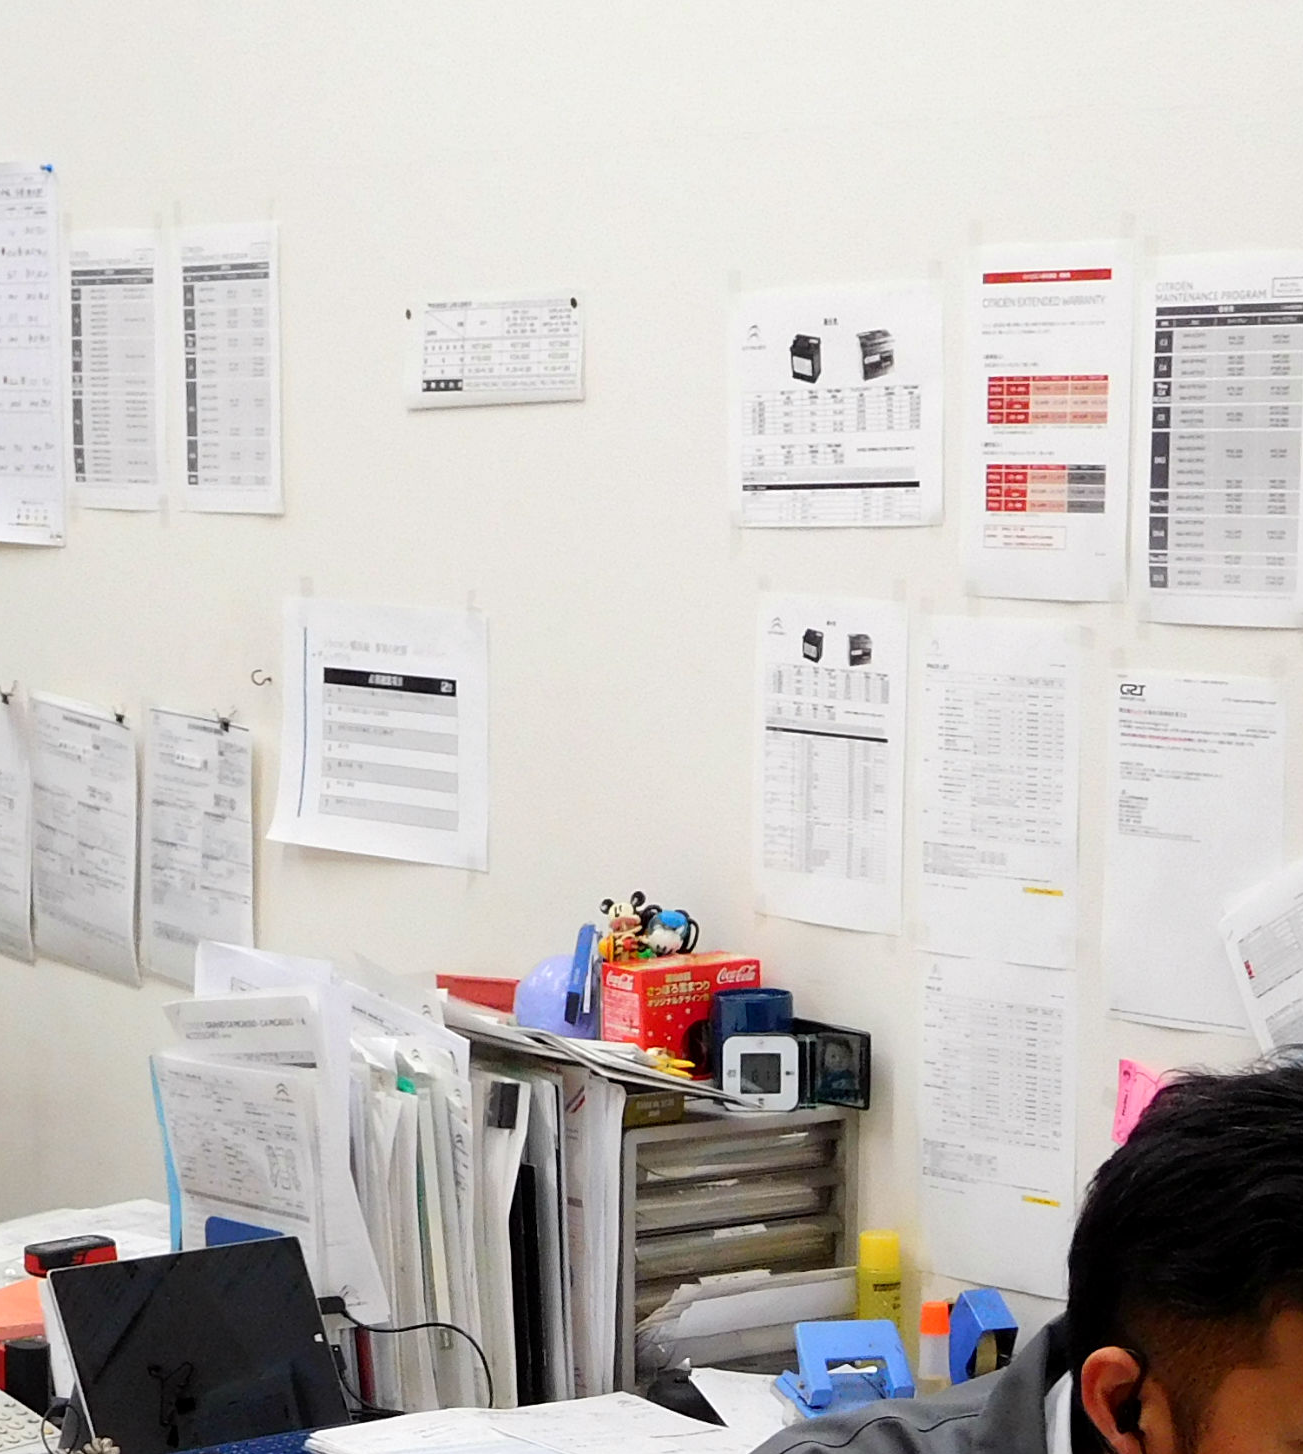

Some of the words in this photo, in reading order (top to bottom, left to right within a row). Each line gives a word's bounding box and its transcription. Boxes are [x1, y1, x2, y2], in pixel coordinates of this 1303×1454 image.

[1017, 295, 1060, 307] EXTENDED
[1062, 294, 1107, 306] WARRANTY
[1155, 291, 1219, 302] MAINTENANCE
[1220, 289, 1267, 300] PROGRAM
